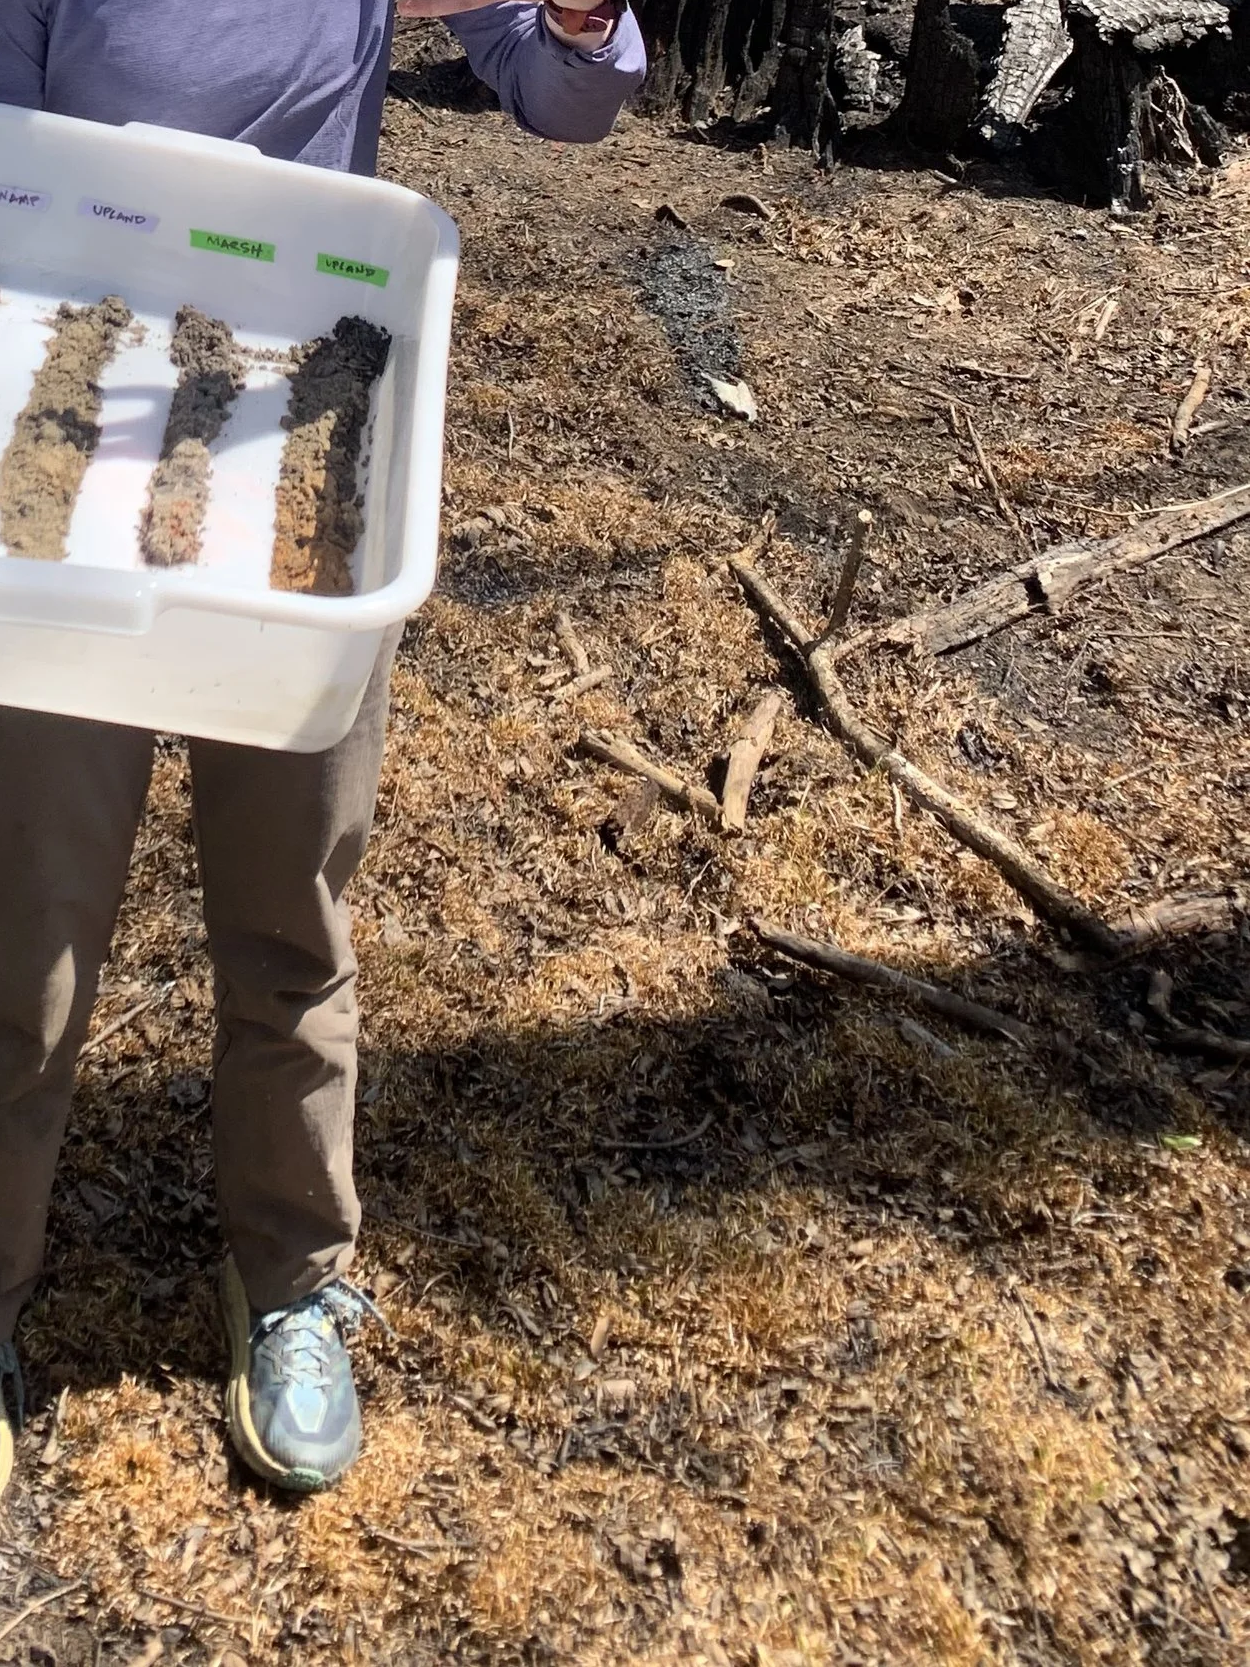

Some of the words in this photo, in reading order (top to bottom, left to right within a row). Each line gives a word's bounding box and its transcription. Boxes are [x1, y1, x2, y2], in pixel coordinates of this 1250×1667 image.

[92, 204, 146, 225] UPLAND
[206, 235, 263, 258] MARSH
[325, 258, 376, 277] UPLAND
